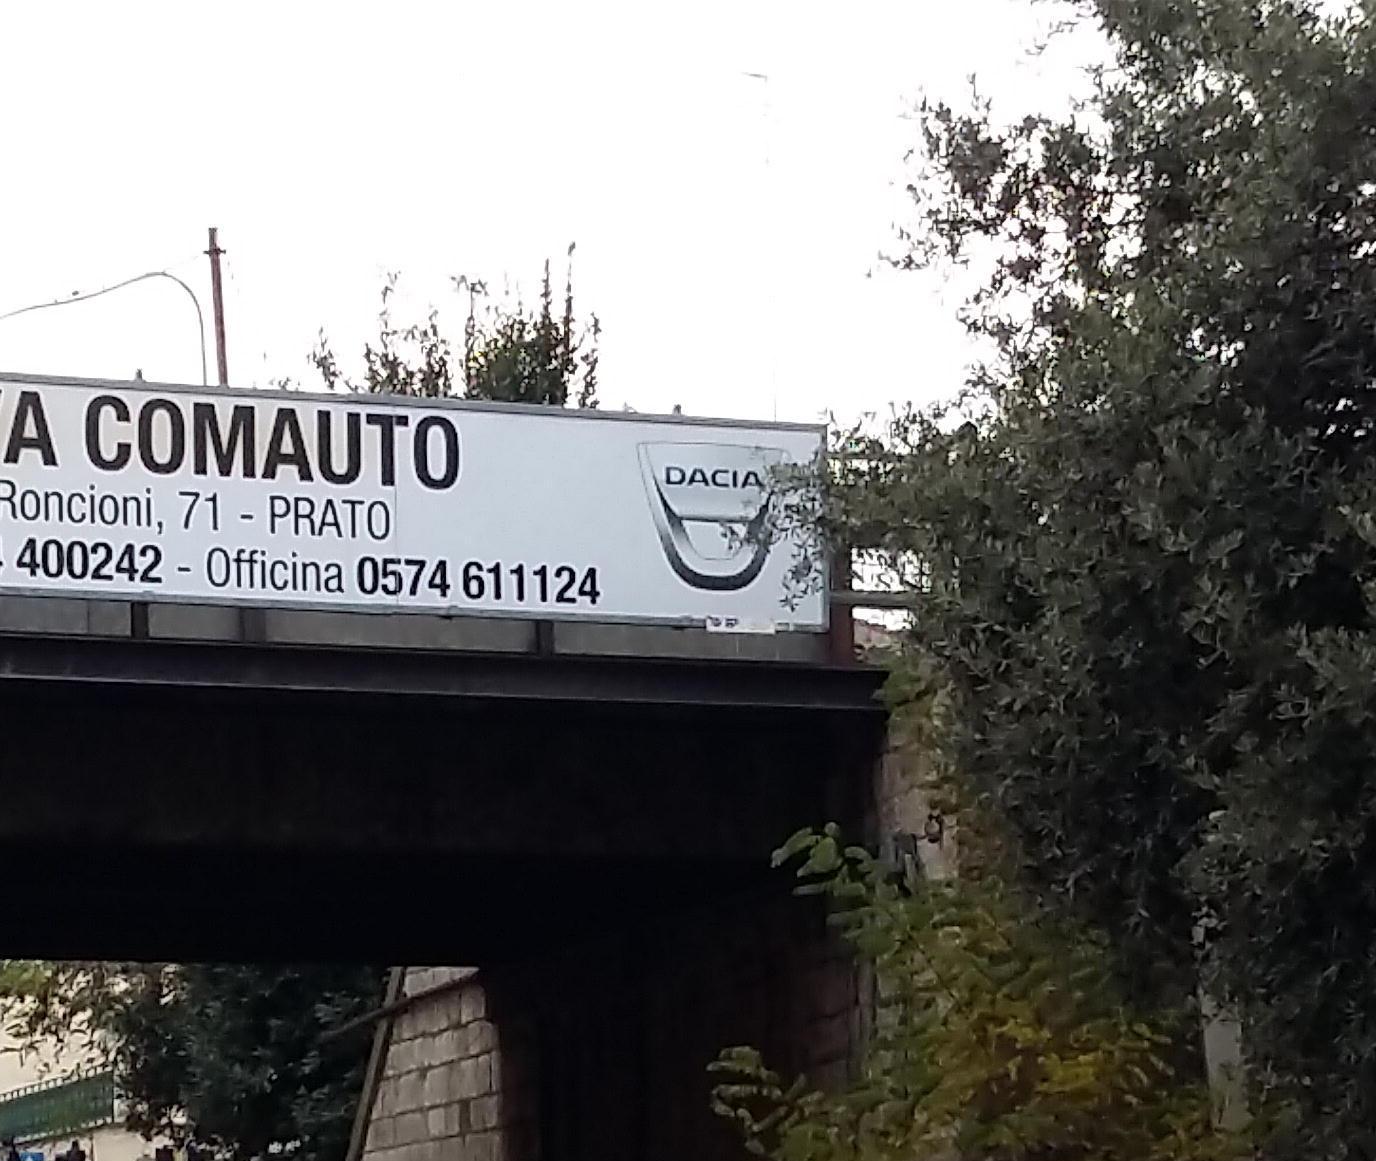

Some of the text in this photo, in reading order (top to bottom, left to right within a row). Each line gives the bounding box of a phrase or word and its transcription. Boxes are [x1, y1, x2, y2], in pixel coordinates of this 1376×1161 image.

[85, 394, 460, 490] COMAUTO
[665, 466, 765, 488] DACIA
[178, 491, 220, 531] 71
[269, 495, 390, 541] PRATO
[16, 537, 163, 584] 400242
[206, 547, 345, 594] Officina
[356, 556, 451, 598] 0574
[462, 561, 601, 605] 611124
